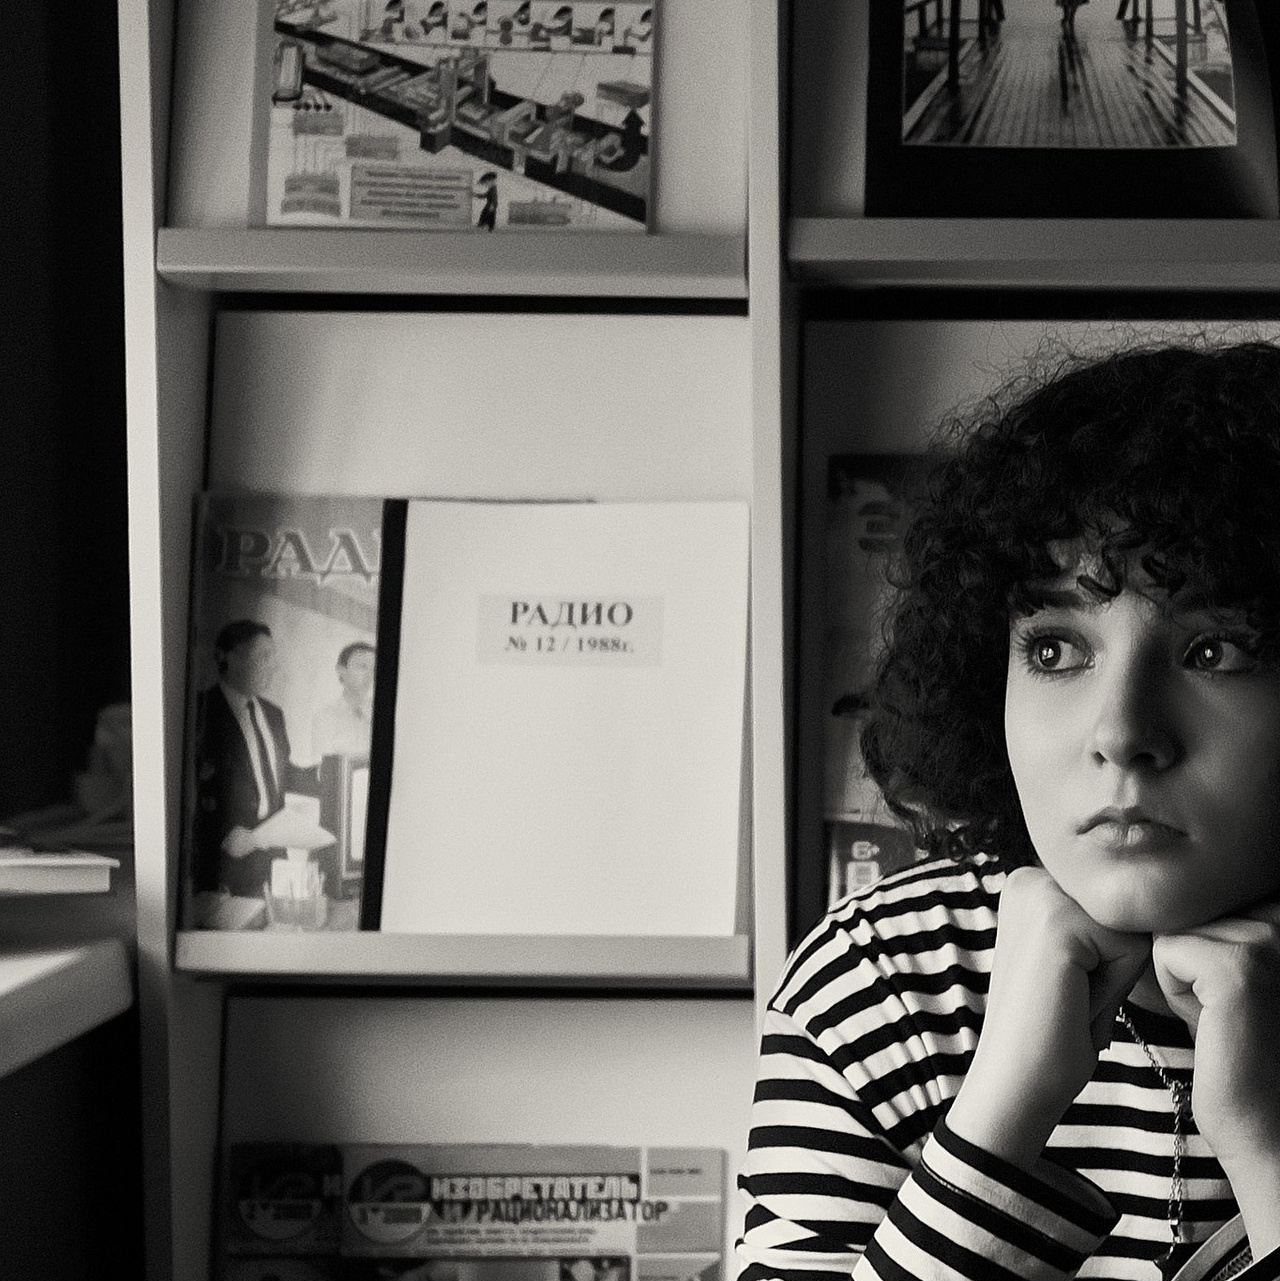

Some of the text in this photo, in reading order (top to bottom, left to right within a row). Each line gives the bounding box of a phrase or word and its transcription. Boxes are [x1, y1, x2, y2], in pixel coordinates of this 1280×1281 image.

[217, 526, 381, 585] РАД
[510, 600, 634, 630] РАДИО
[537, 636, 556, 652] 12
